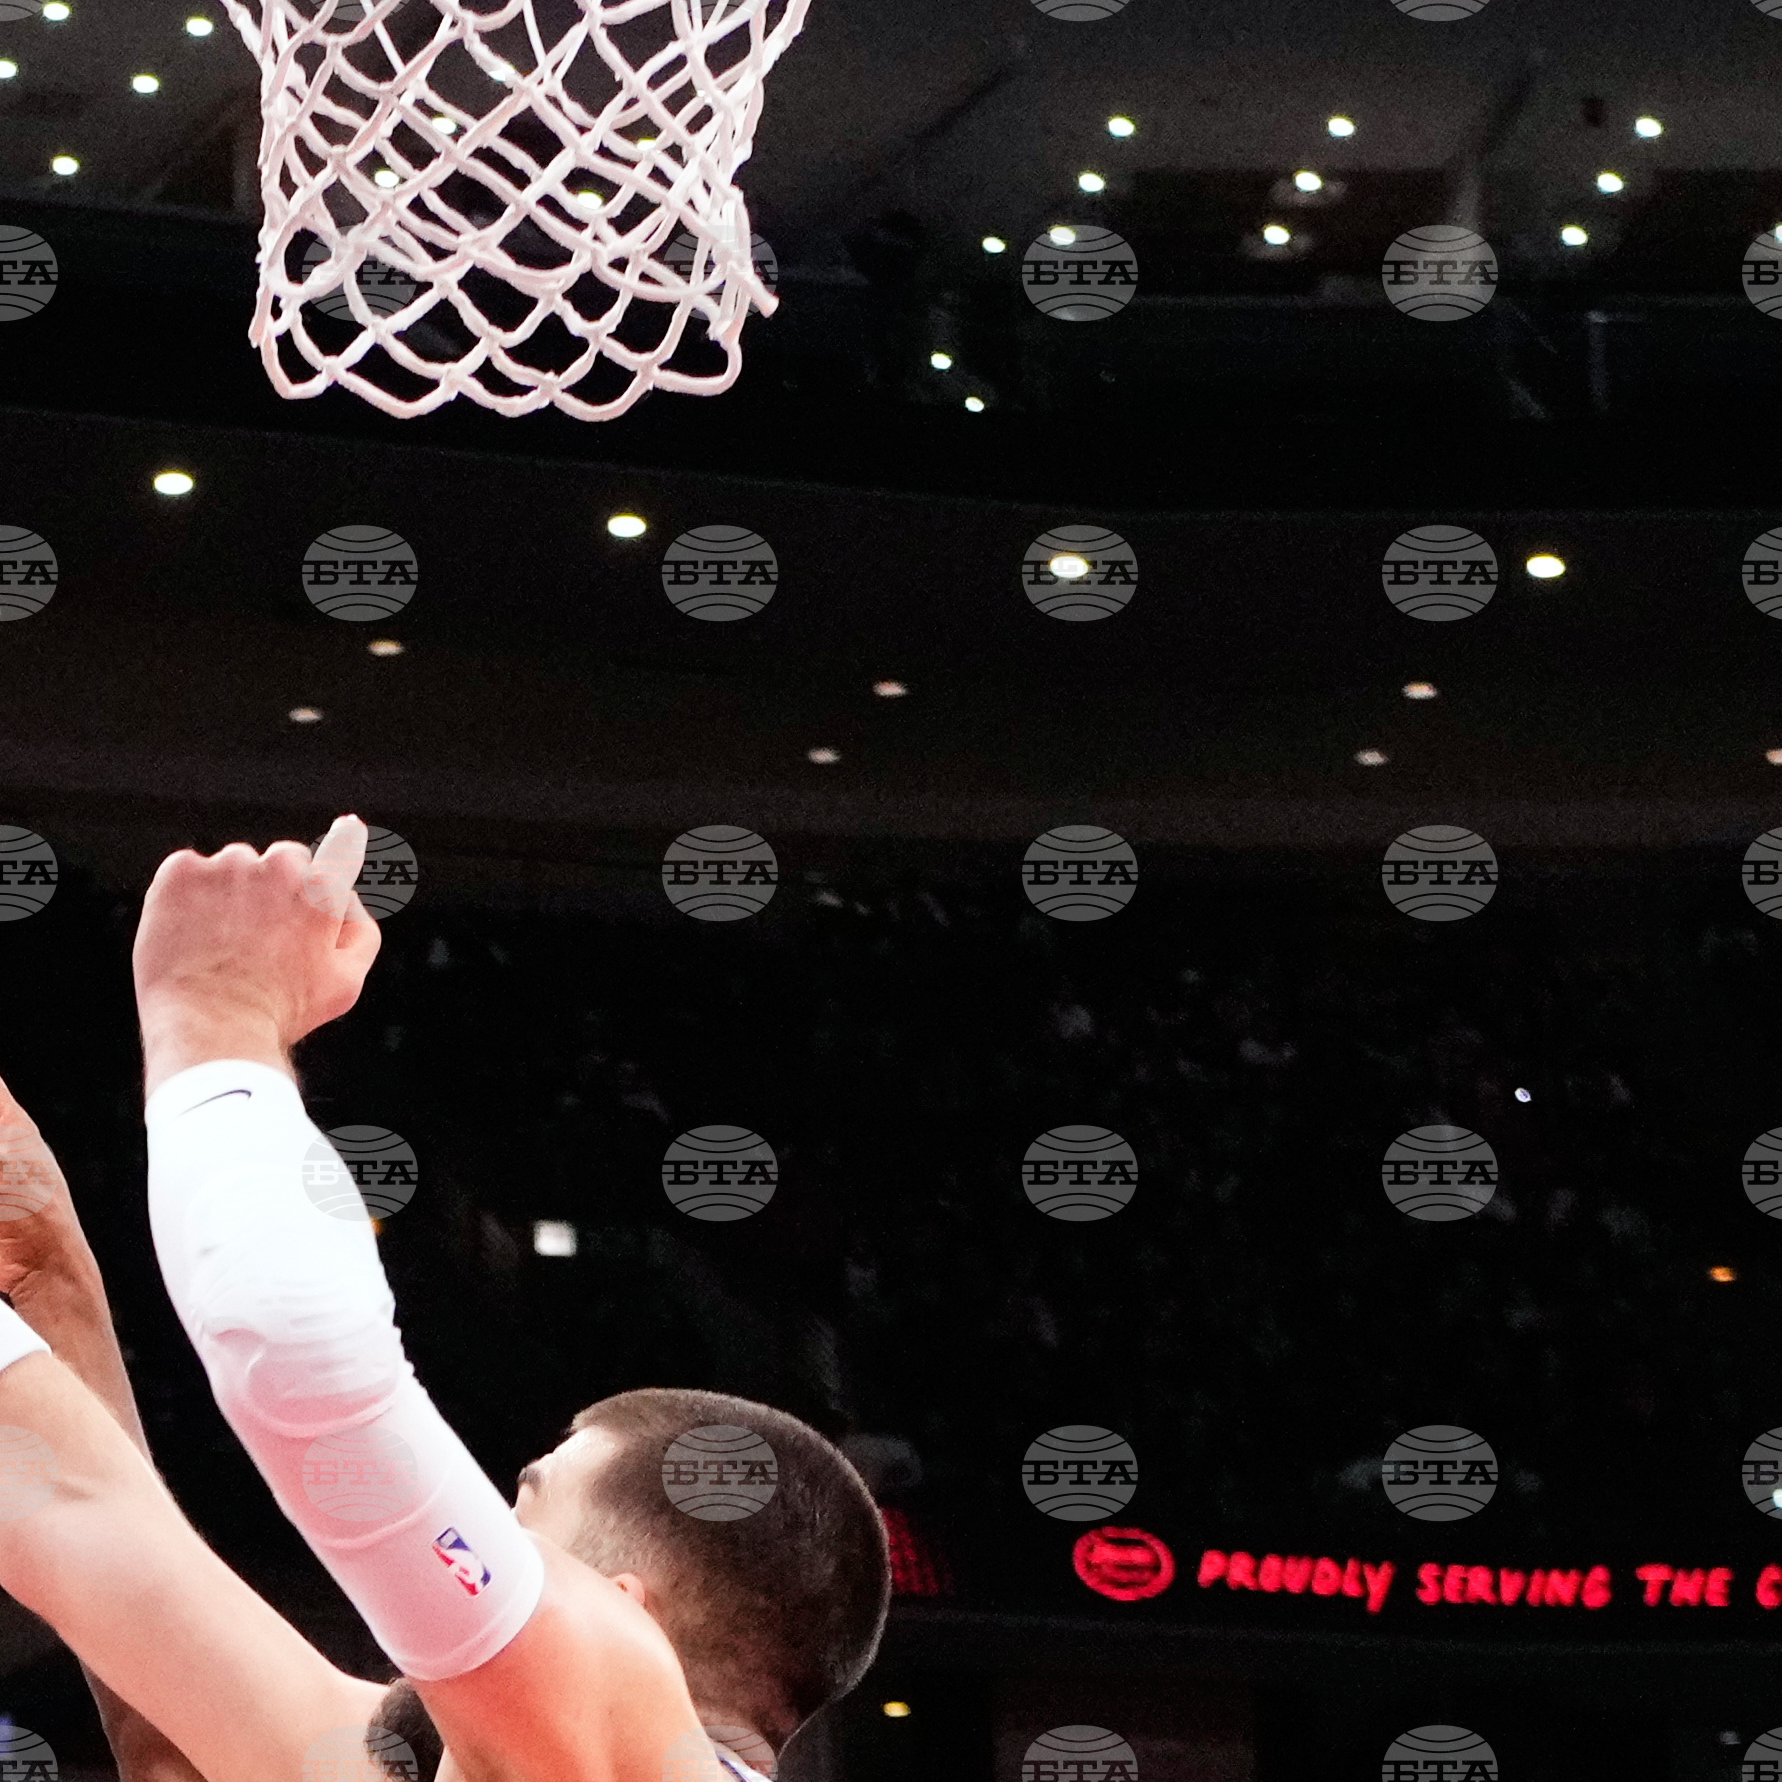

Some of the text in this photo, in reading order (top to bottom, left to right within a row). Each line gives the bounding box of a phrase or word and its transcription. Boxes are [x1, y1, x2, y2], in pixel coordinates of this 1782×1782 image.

[1197, 1549, 1396, 1614] PROUDLY
[1417, 1563, 1611, 1610] SERVING
[1635, 1563, 1733, 1608] THE
